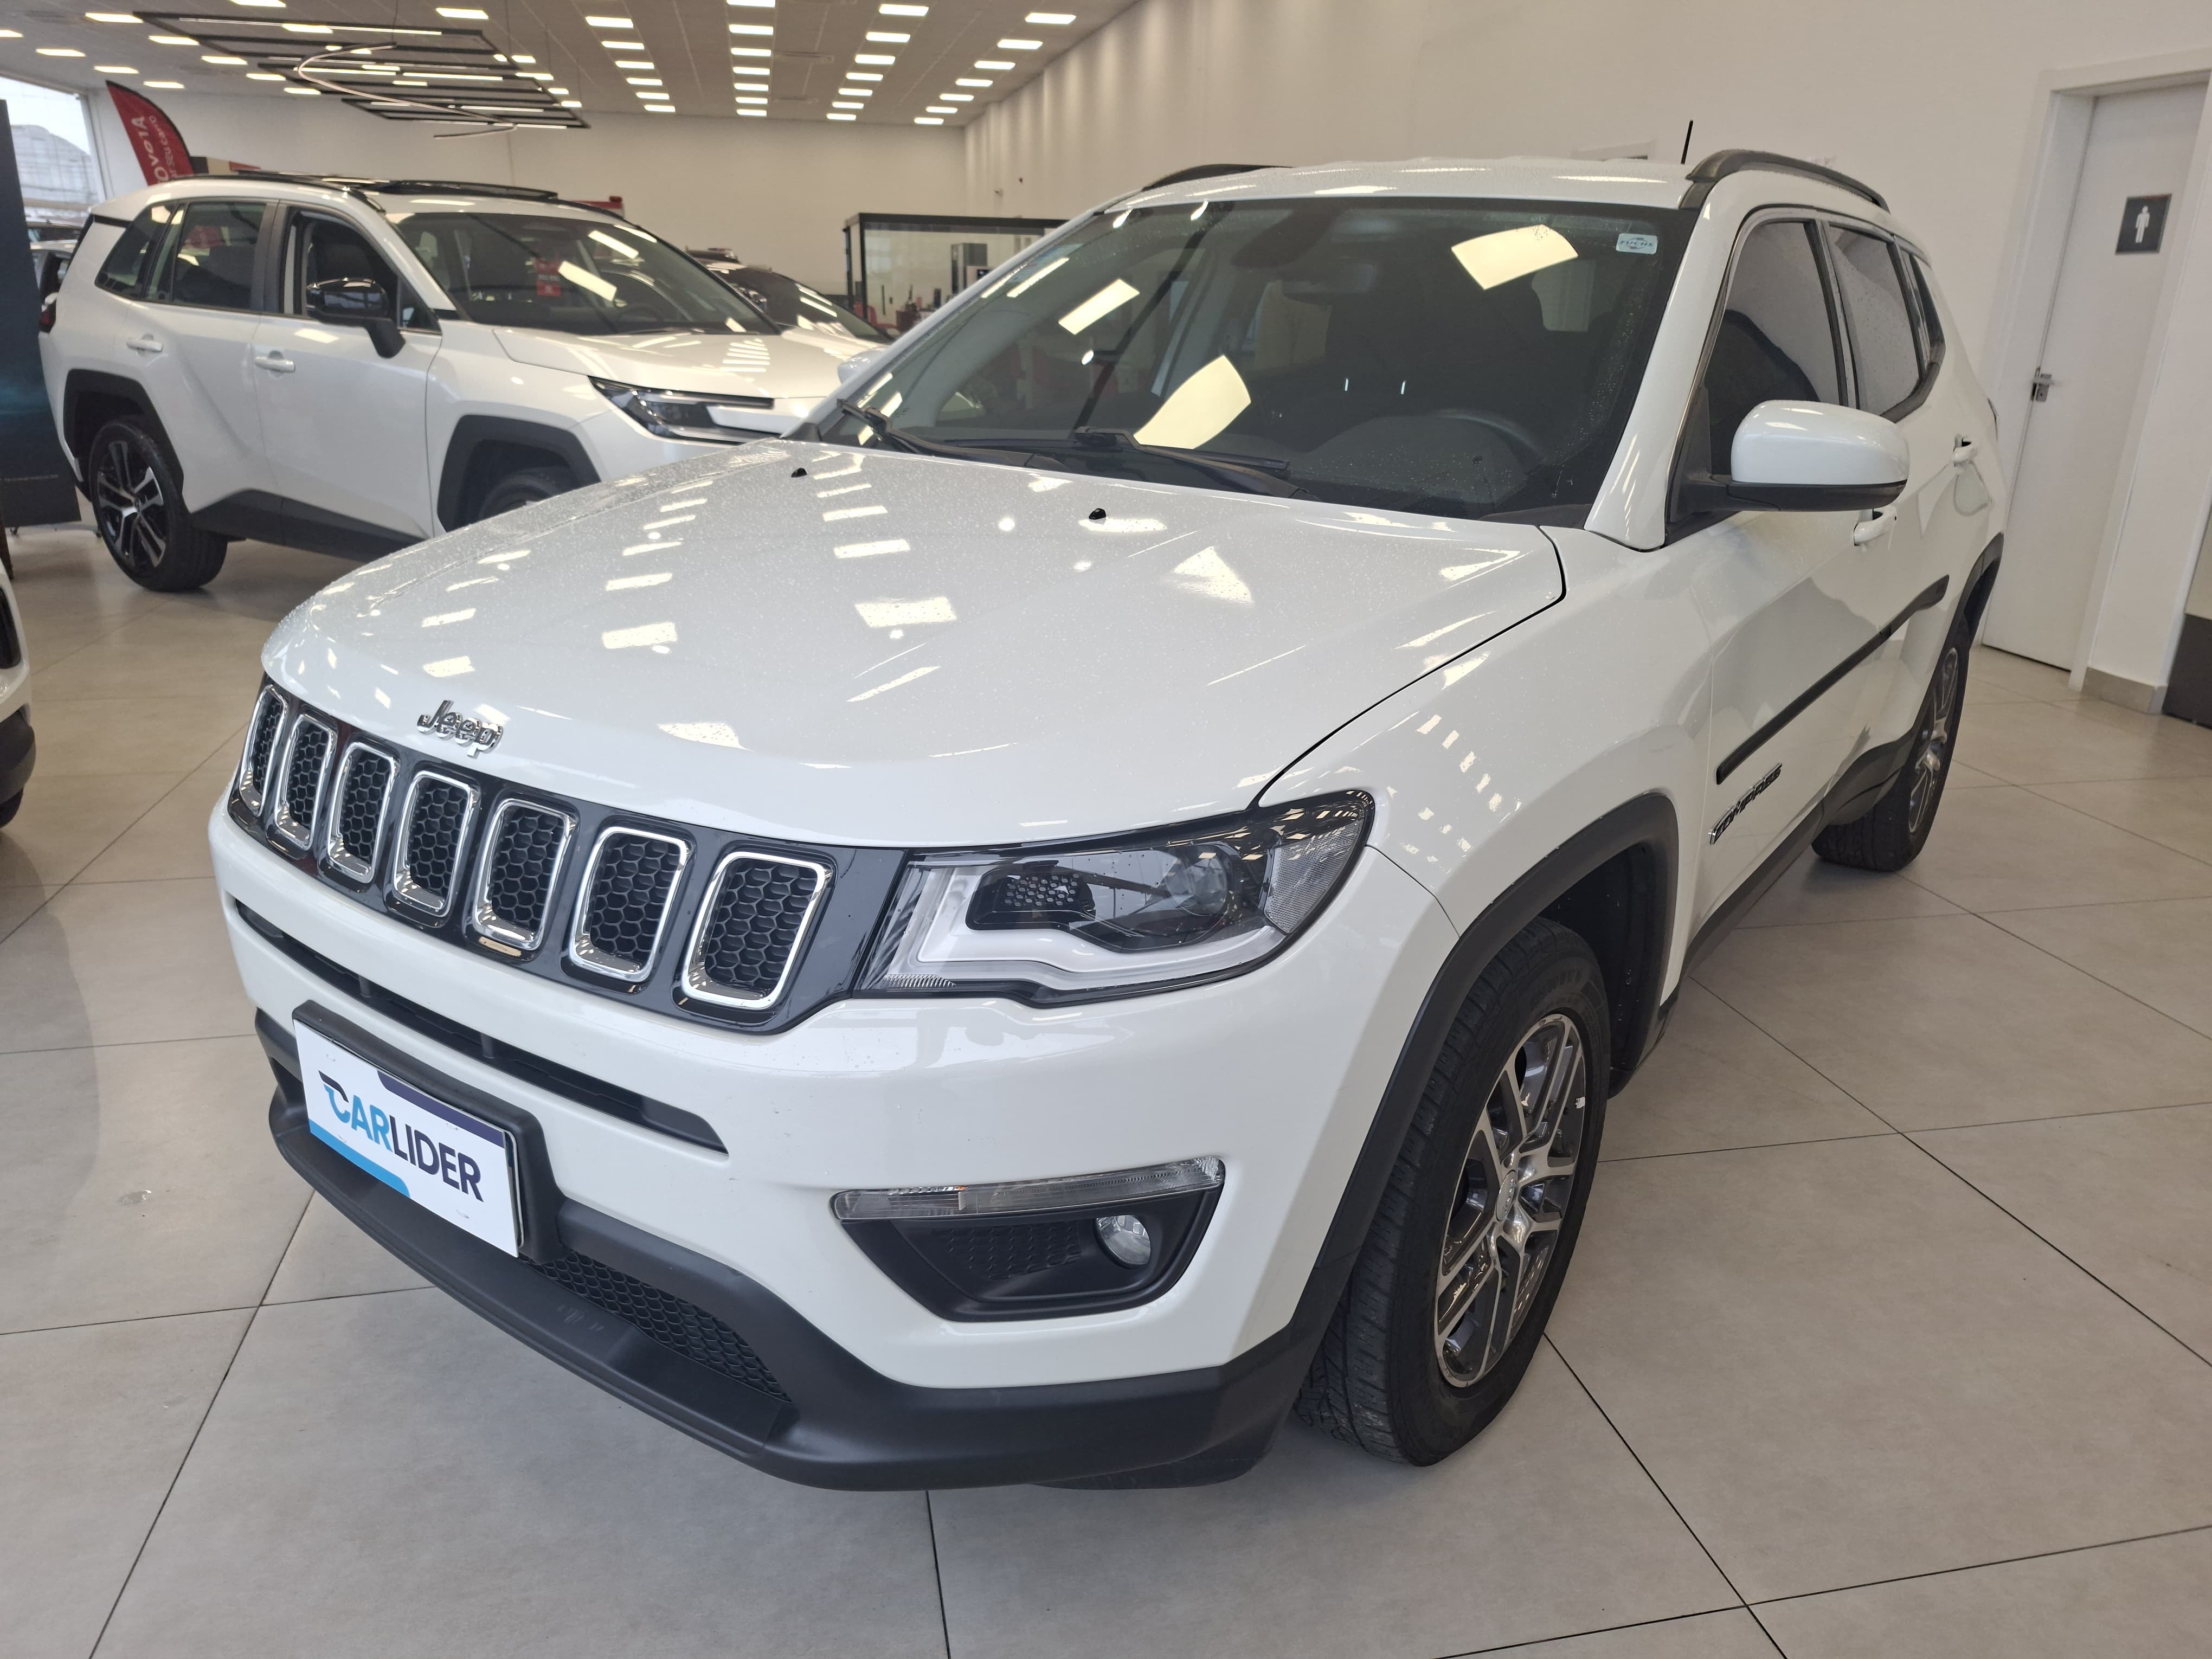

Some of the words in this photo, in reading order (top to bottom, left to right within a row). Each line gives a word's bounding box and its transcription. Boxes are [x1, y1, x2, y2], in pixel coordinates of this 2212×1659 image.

[131, 115, 169, 183] OYOTA
[416, 700, 504, 759] Jeep
[318, 1070, 484, 1203] CARLIDER
